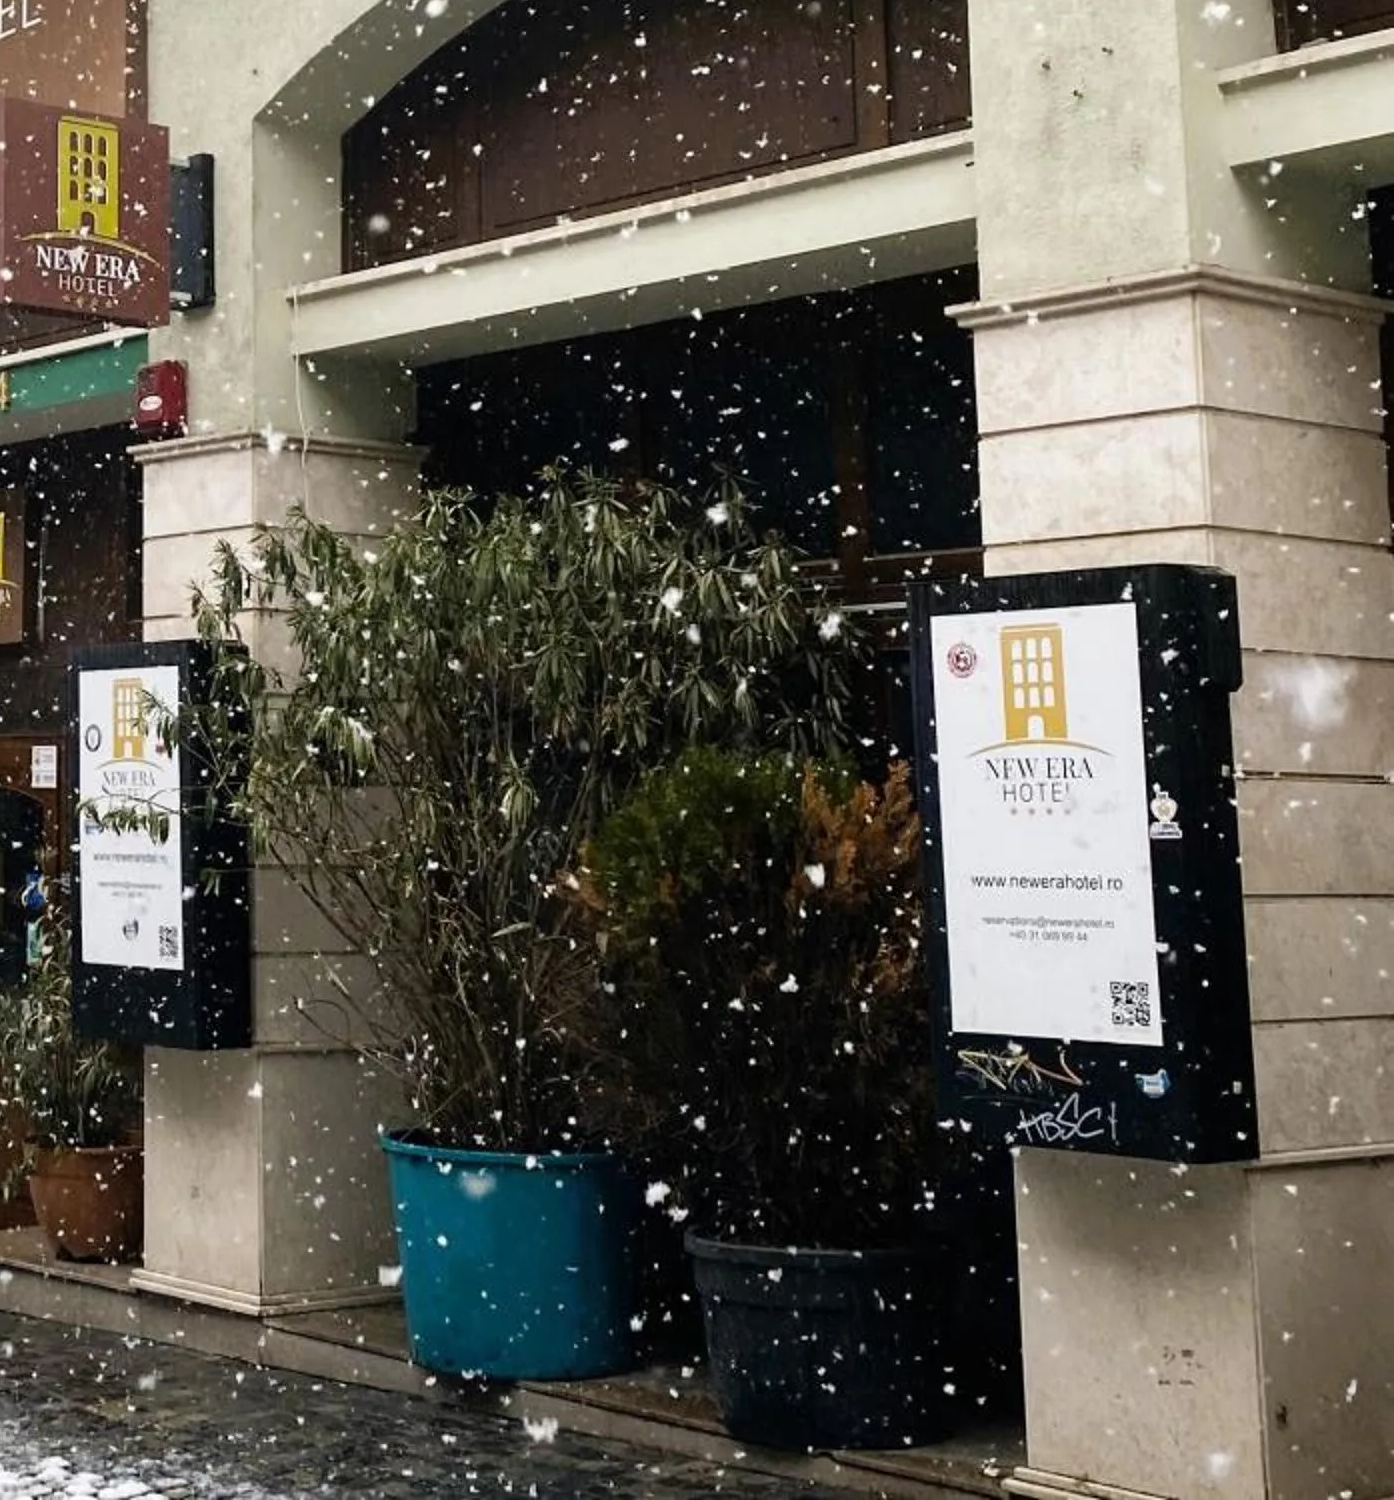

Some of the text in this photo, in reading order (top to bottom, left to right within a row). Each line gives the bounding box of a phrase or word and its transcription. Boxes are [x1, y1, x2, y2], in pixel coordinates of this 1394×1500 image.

[36, 244, 140, 282] NEW ERA
[58, 273, 116, 297] HOTEL
[986, 757, 1094, 780] NEW ERA
[1002, 782, 1071, 803] HOTEL
[971, 874, 1124, 891] www.newerahotel.ro
